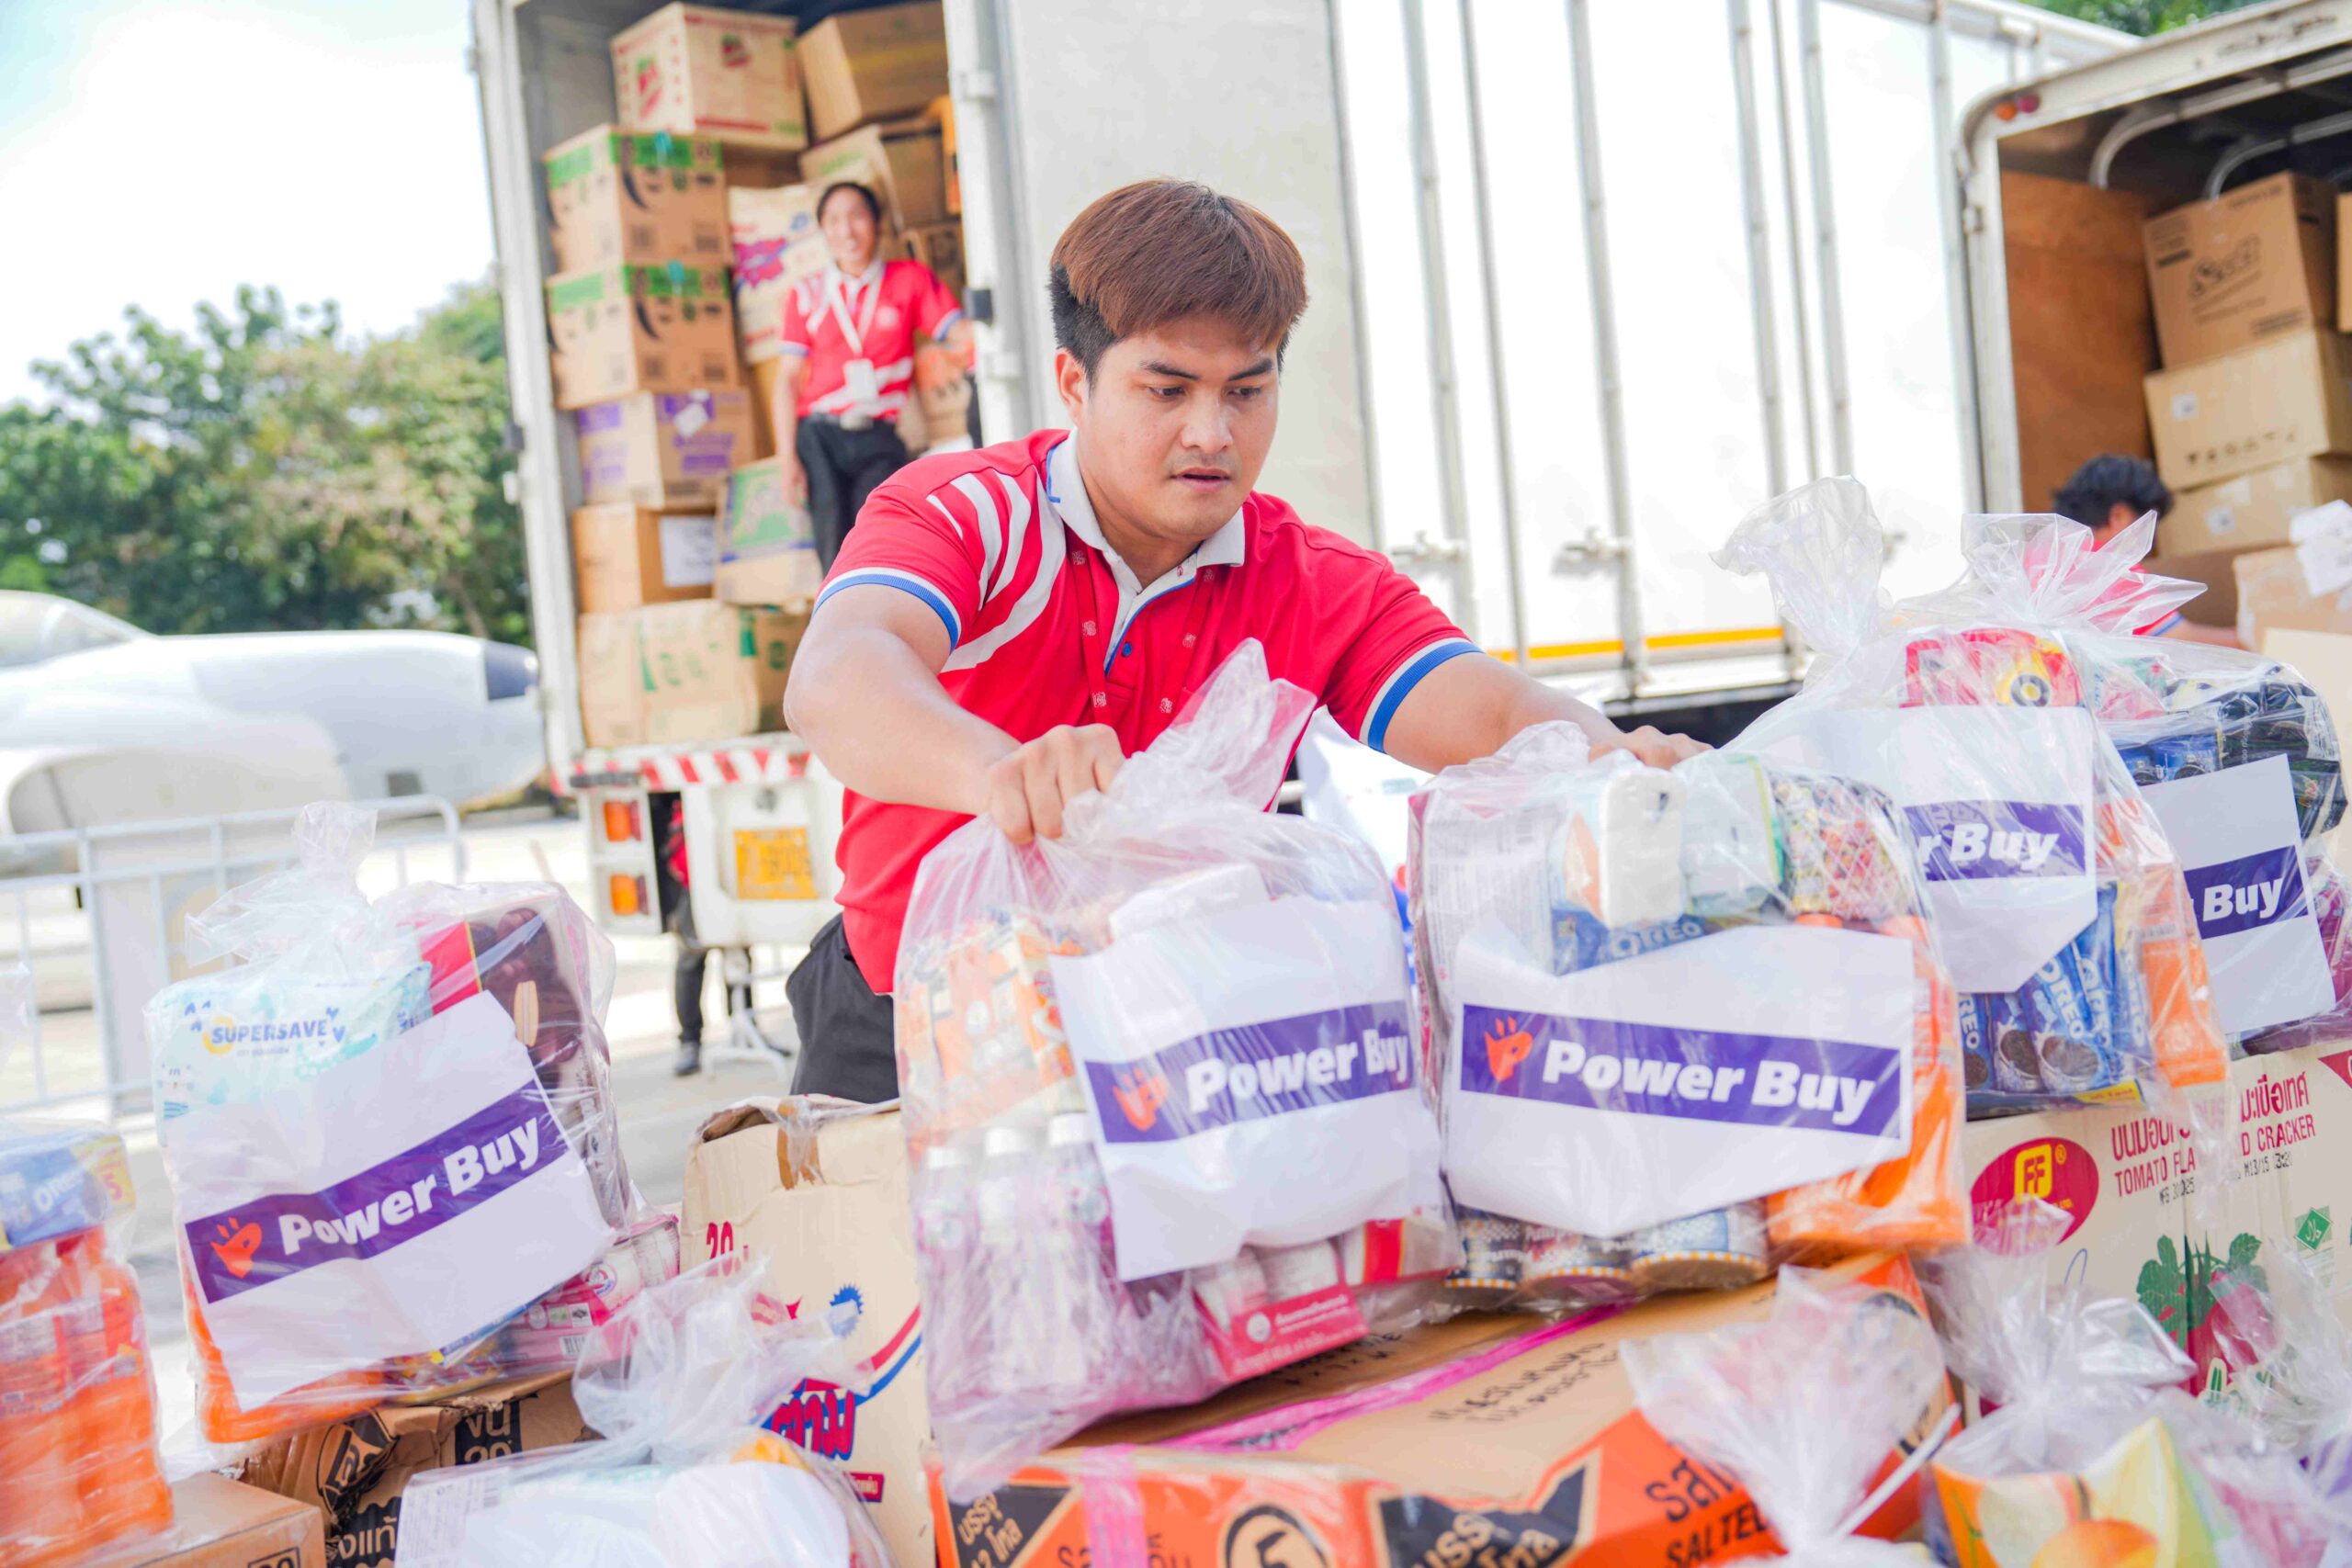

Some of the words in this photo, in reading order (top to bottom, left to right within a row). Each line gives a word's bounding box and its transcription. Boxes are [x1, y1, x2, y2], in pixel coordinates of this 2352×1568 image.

[1949, 822, 2060, 871] Buy
[2202, 877, 2284, 922] Buy
[210, 1020, 327, 1045] SUPERSAVE
[1959, 994, 1980, 1049] REO
[1185, 1042, 1359, 1114] Power
[1362, 1028, 1408, 1083] Buy
[1542, 1039, 1746, 1102] Power
[1751, 1059, 1876, 1126] Buy
[278, 1173, 436, 1256] Power
[443, 1117, 540, 1197] Buy
[2114, 1156, 2168, 1198] TOMATO
[2257, 1113, 2316, 1152] CRACKER
